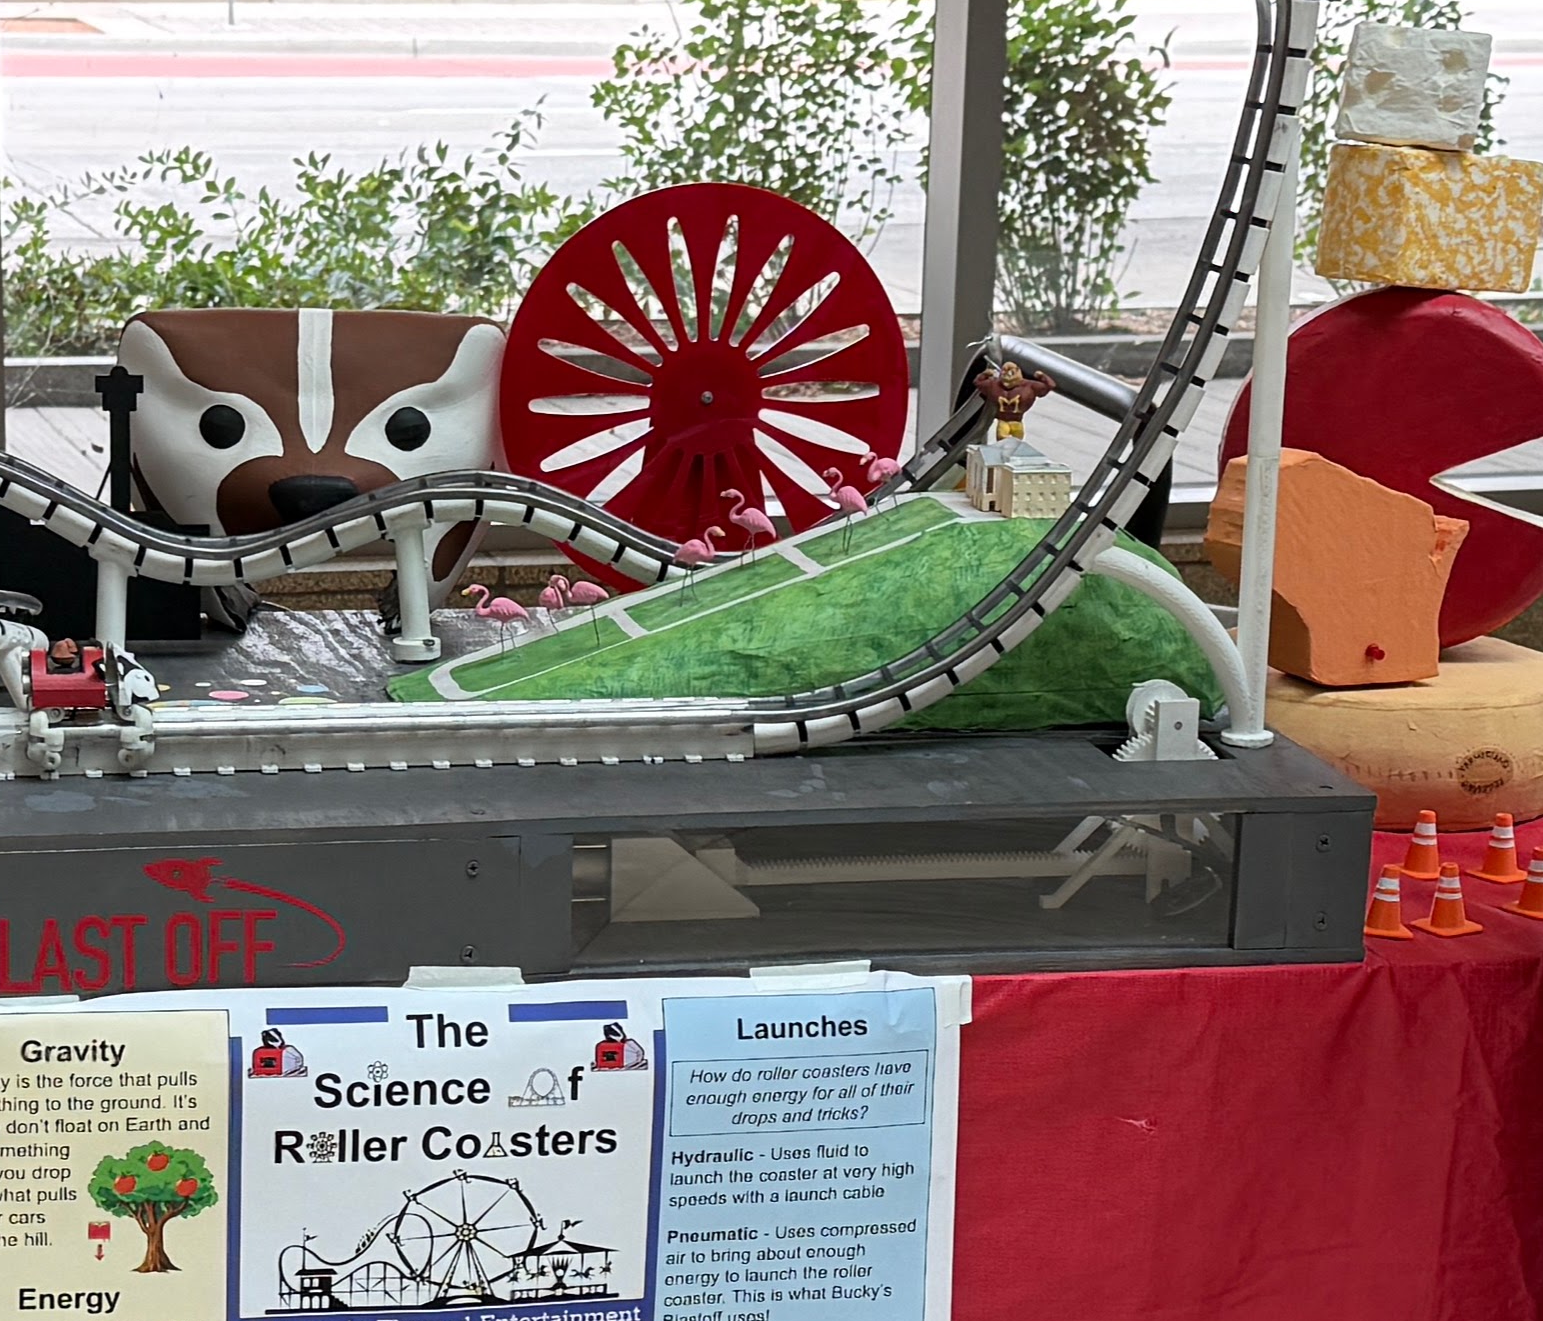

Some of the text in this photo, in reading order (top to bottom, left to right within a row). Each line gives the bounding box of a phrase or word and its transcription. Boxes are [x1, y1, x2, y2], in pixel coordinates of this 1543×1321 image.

[998, 394, 1021, 413] M
[164, 908, 279, 986] OFF
[406, 1013, 489, 1049] The
[736, 1014, 867, 1040] Launches
[20, 1038, 125, 1067] Gravity
[16, 1073, 30, 1089] is
[35, 1073, 63, 1089] the
[68, 1072, 113, 1088] force
[118, 1071, 151, 1087] that
[156, 1070, 197, 1090] pulls
[45, 1097, 61, 1111] to
[66, 1095, 94, 1110] the
[173, 1093, 197, 1109] It's
[5, 1118, 49, 1134] don't
[54, 1118, 92, 1133] float
[97, 1120, 119, 1133] on
[125, 1116, 171, 1132] Earth
[177, 1115, 210, 1131] and
[730, 1104, 869, 1127] drops and tricks?
[31, 1165, 71, 1182] drop
[669, 1161, 914, 1186] launch the coaster at very high
[36, 1186, 77, 1205] pulls
[8, 1212, 46, 1225] cars
[24, 1231, 52, 1246] hill.
[18, 1287, 120, 1314] Energy
